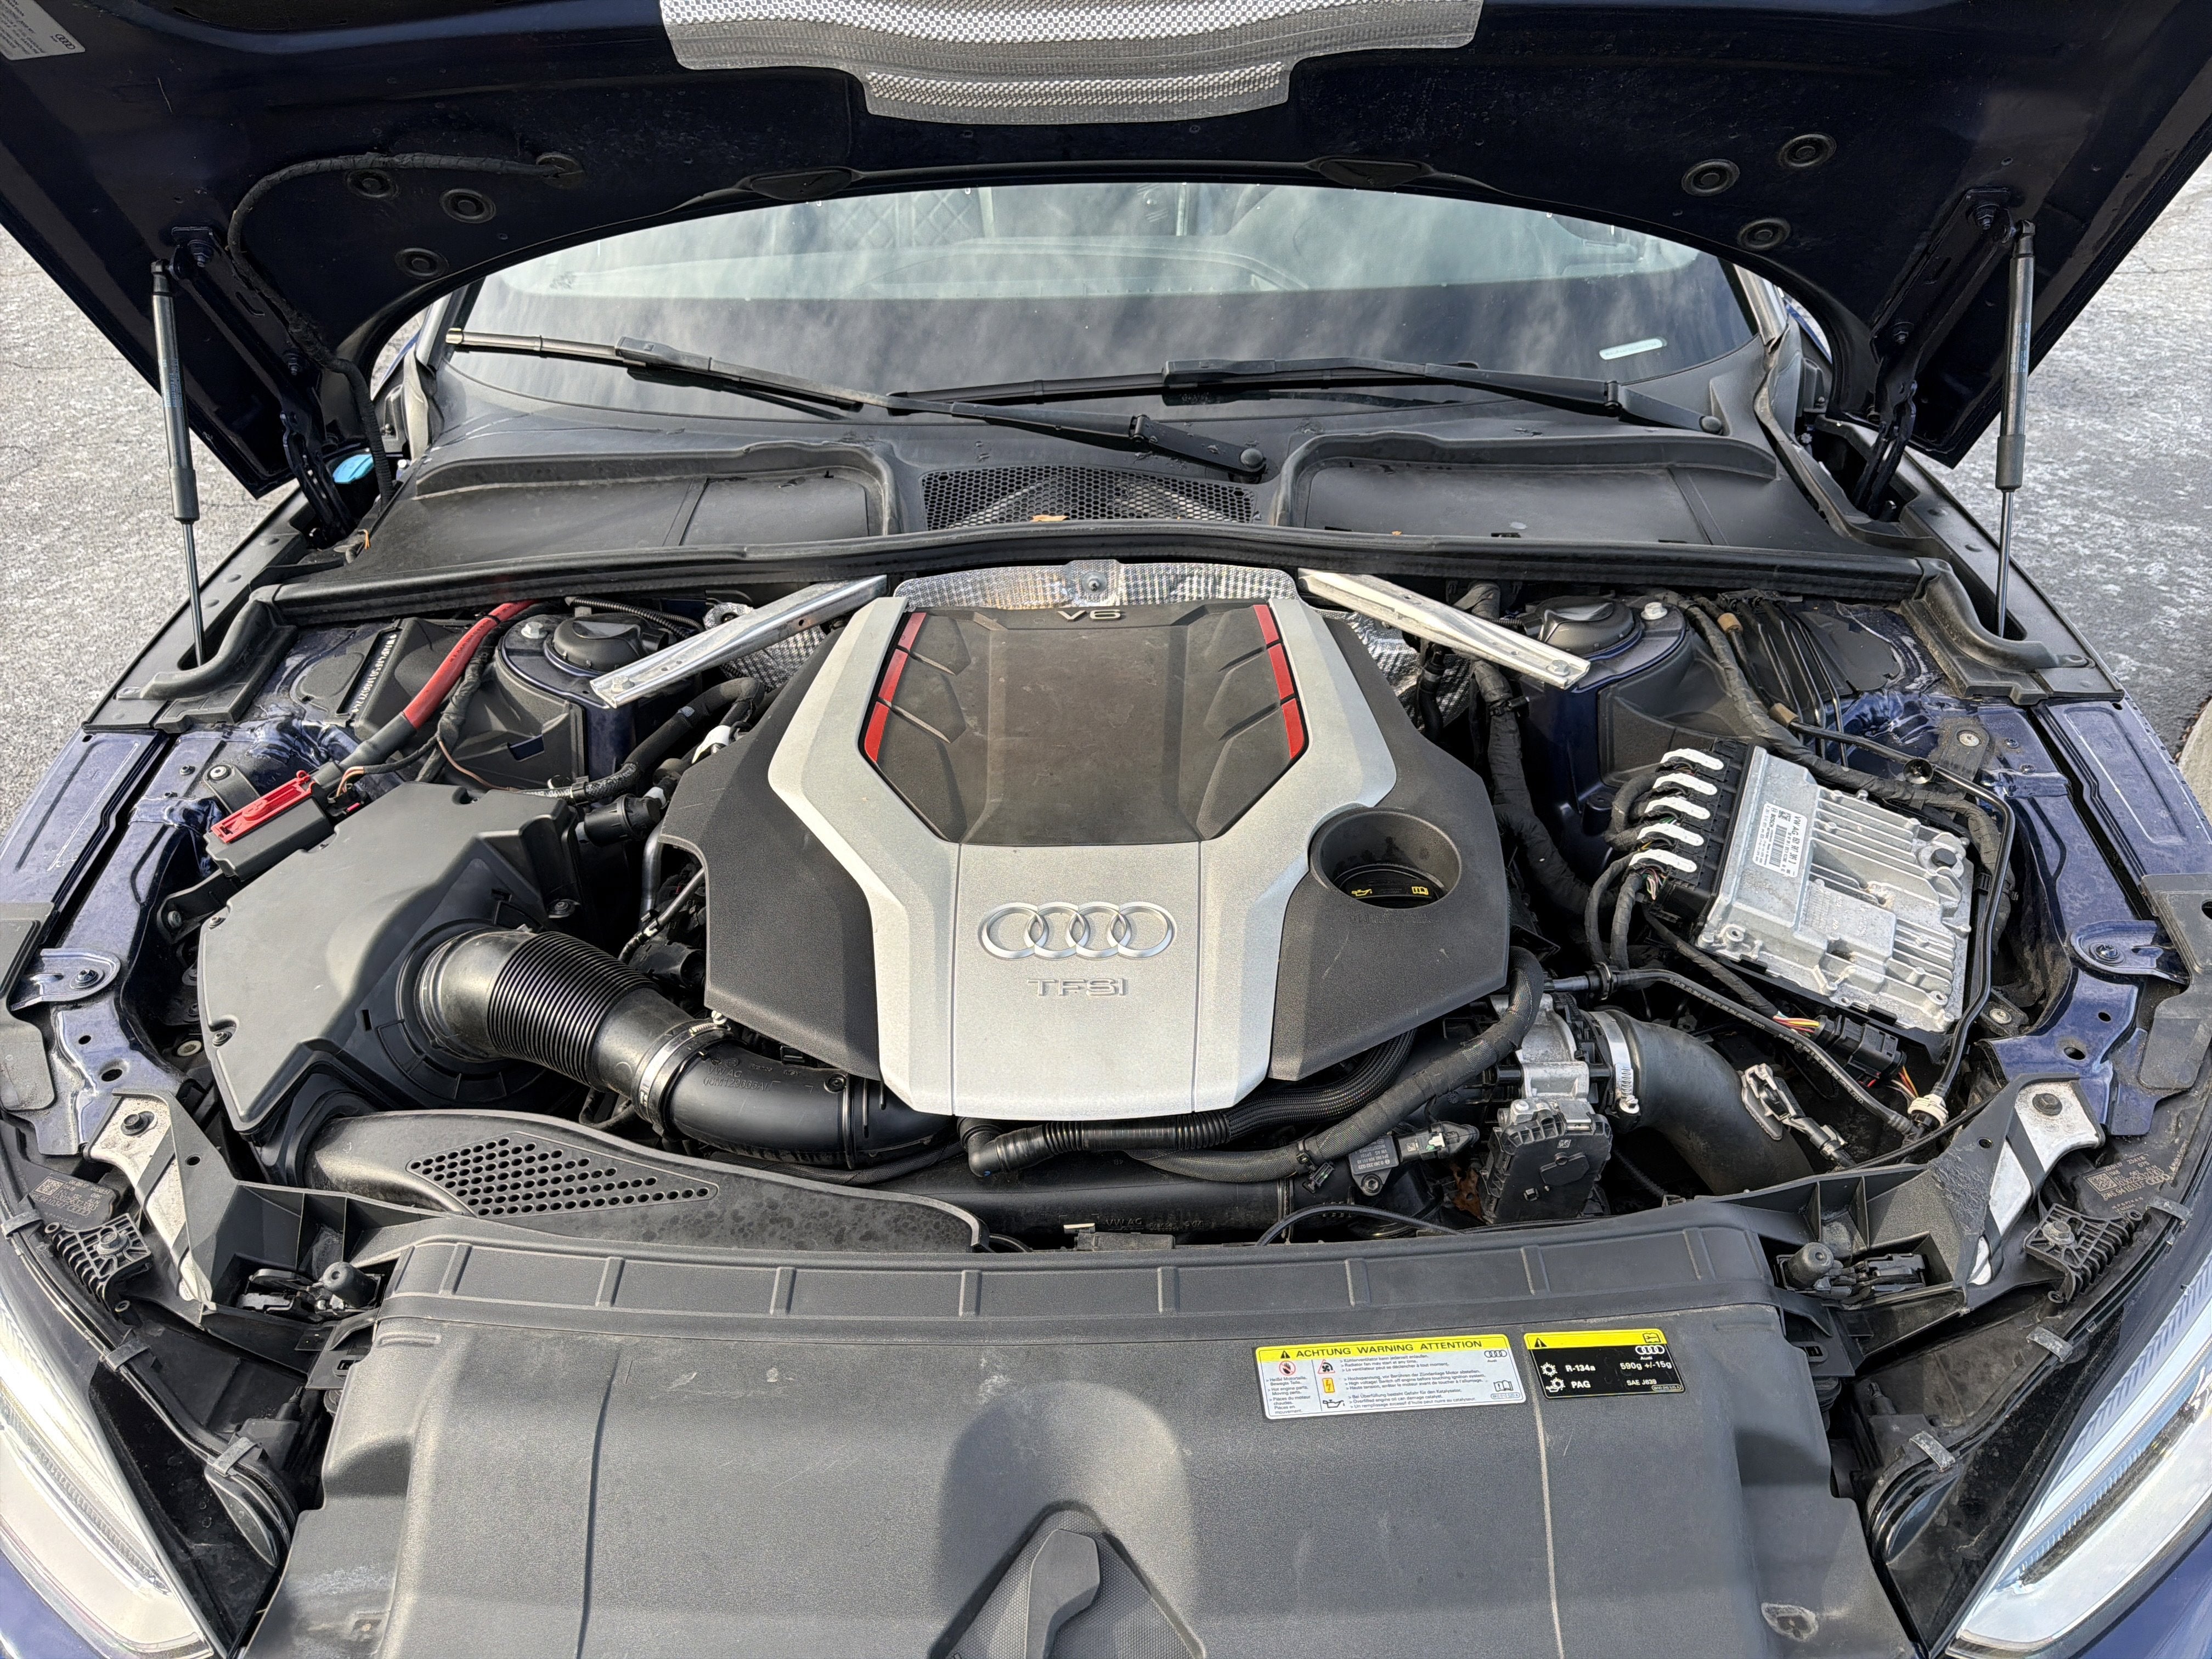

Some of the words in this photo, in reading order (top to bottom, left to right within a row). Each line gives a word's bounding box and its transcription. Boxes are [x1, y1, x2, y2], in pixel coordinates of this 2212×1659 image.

[1056, 608, 1122, 622] V6
[1793, 815, 1801, 826] VW
[1791, 826, 1799, 836] AG
[1026, 978, 1128, 997] TFSI
[707, 1066, 726, 1076] VW
[727, 1069, 742, 1077] AG
[1296, 1348, 1351, 1357] ACHTUNG
[1357, 1344, 1414, 1353] WARNING
[1419, 1340, 1482, 1350] ATTENTION
[1620, 1362, 1643, 1370] 590g
[1644, 1361, 1672, 1369] +/-15g
[1571, 1380, 1591, 1389] PAG
